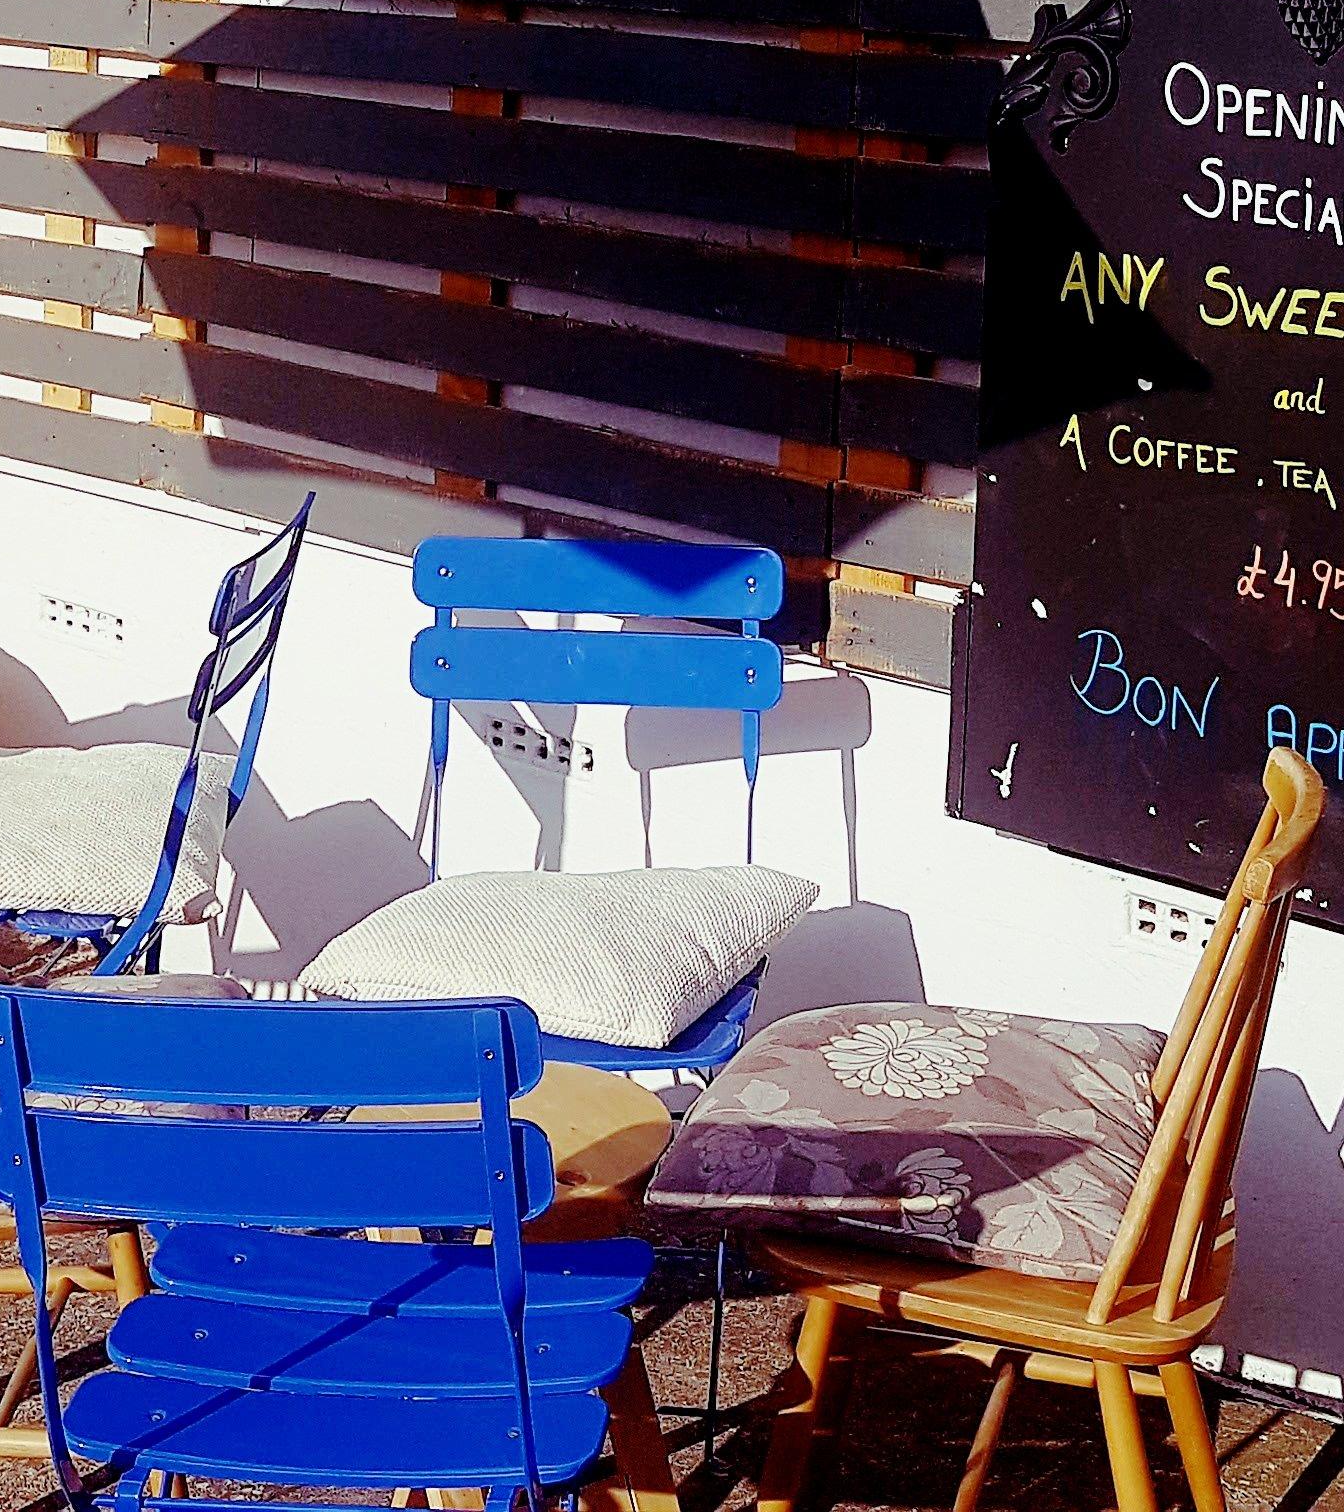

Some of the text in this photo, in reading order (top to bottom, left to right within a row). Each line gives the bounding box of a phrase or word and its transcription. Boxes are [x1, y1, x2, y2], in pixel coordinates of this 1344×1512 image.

[1061, 252, 1164, 323] ANY
[1274, 378, 1325, 414] and
[1060, 414, 1086, 471] A
[1109, 425, 1237, 473] COFFEE
[1070, 630, 1219, 737] BON
